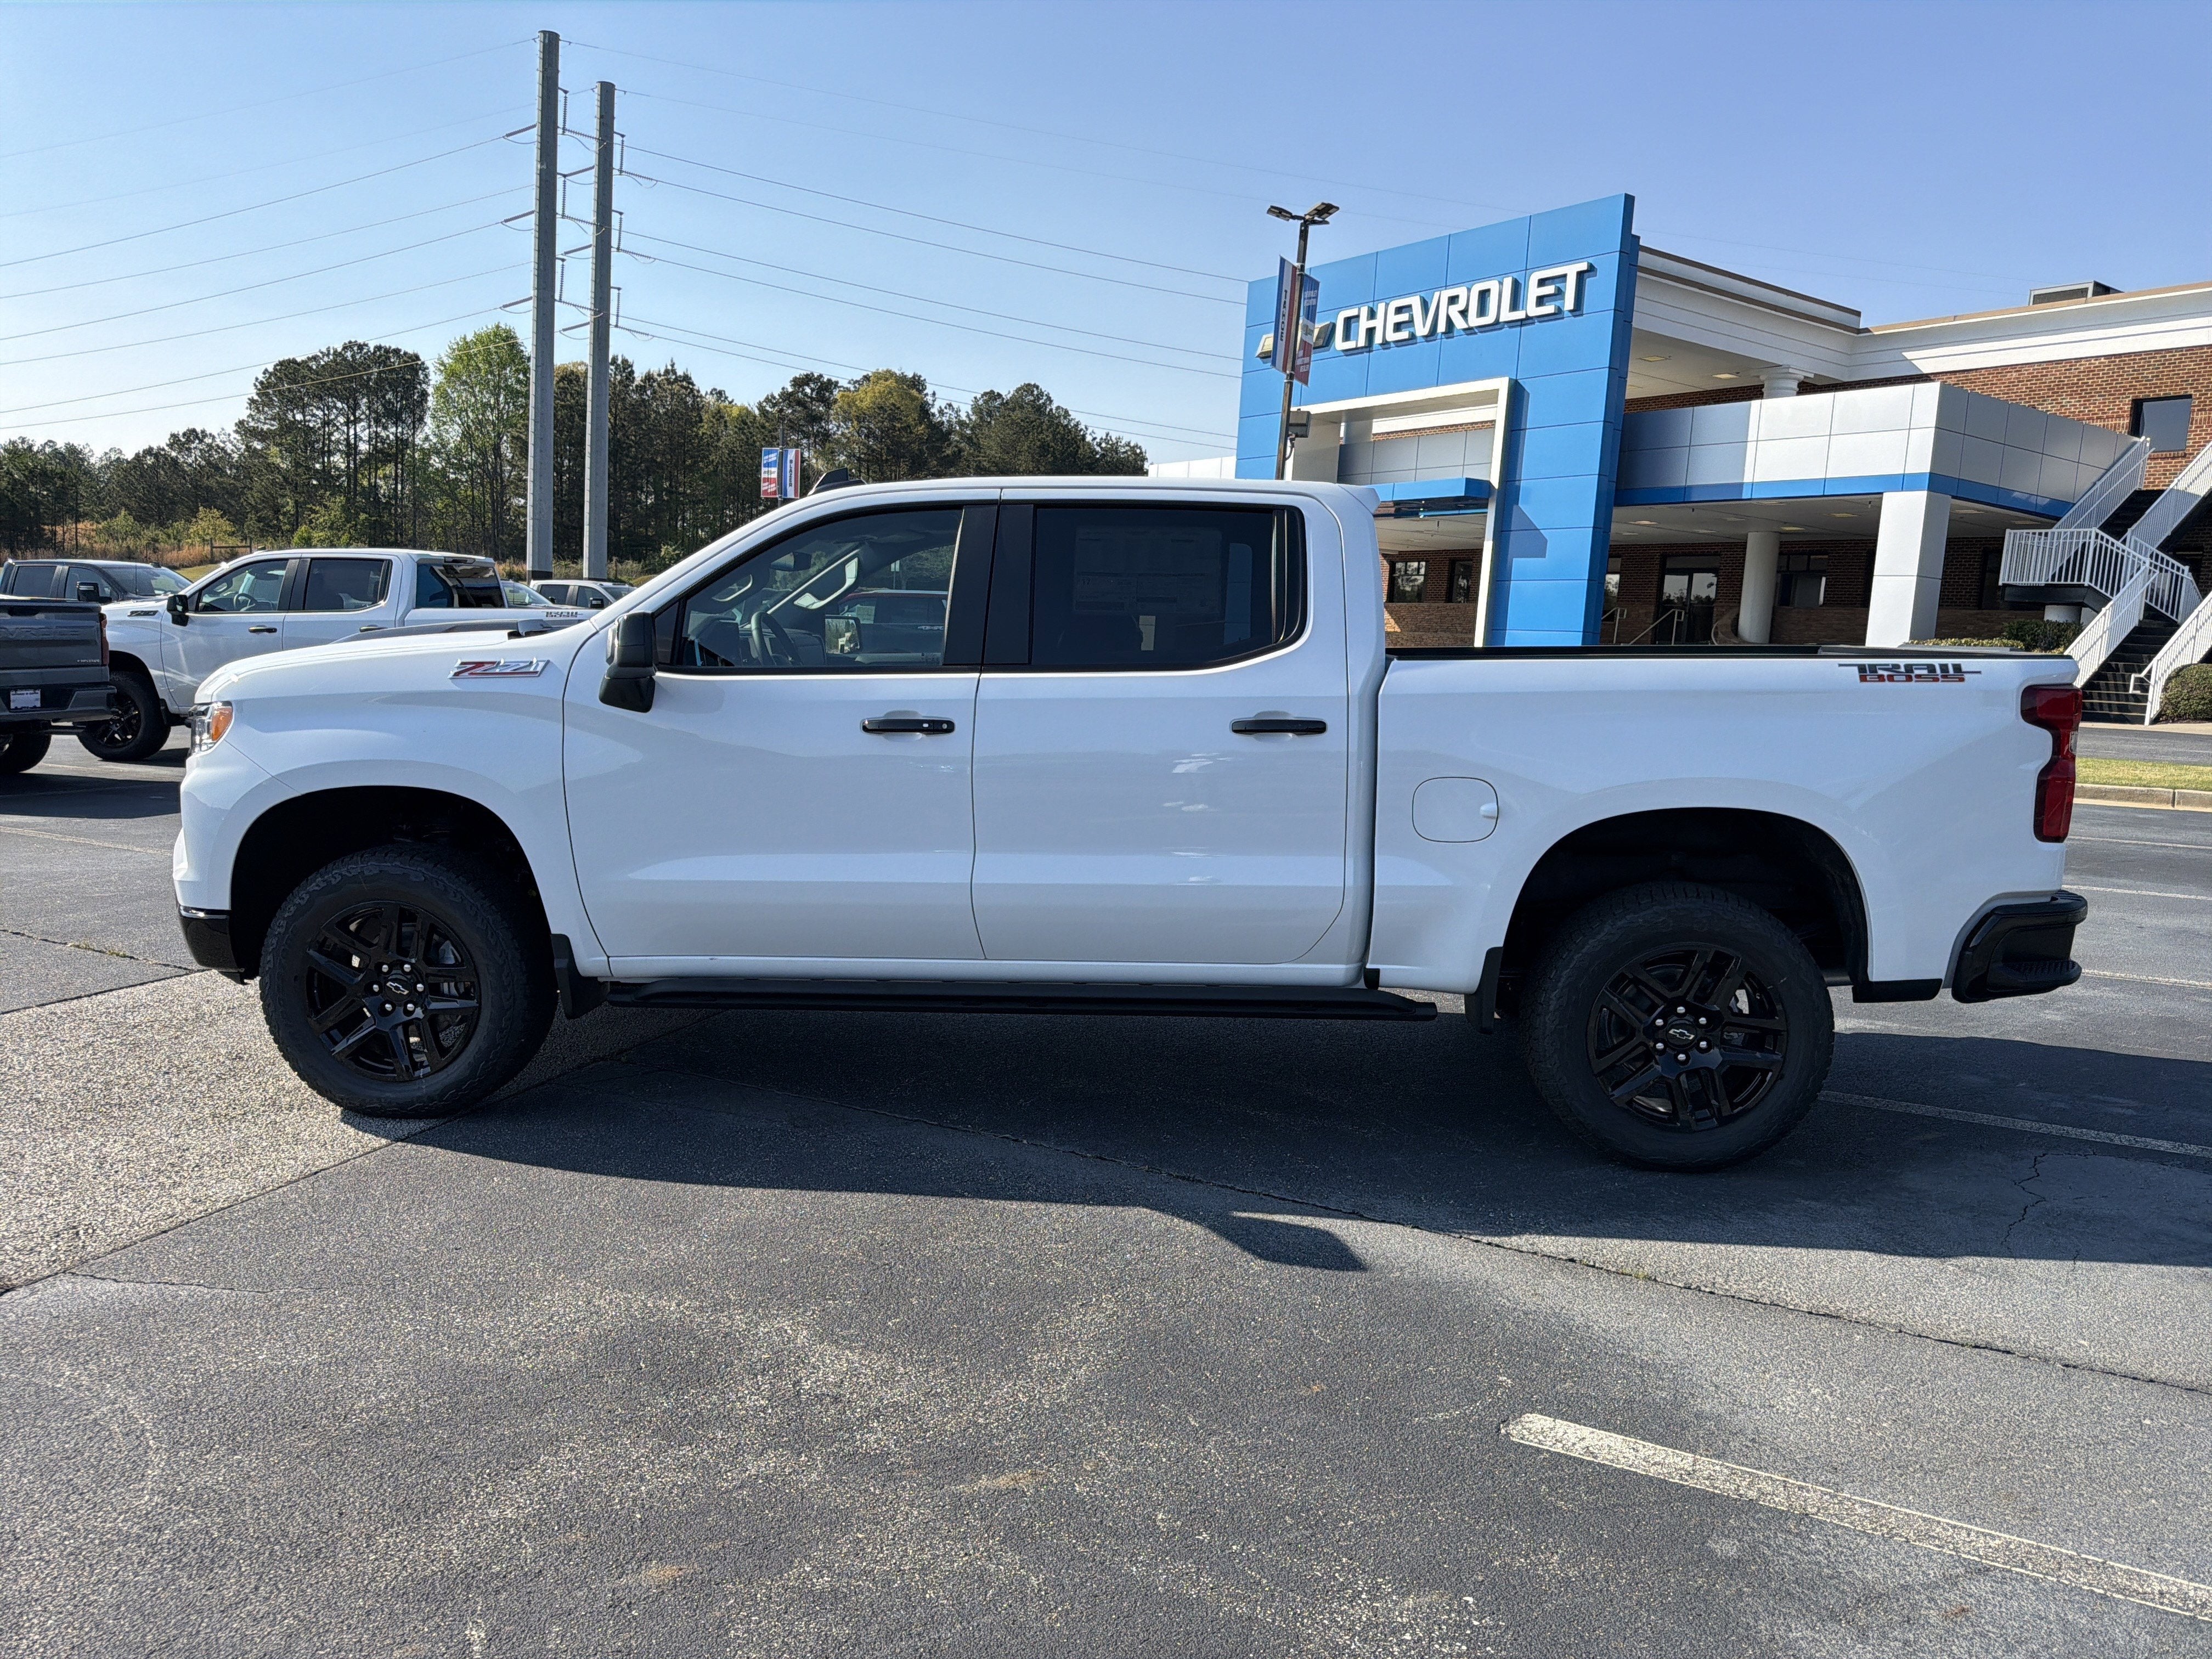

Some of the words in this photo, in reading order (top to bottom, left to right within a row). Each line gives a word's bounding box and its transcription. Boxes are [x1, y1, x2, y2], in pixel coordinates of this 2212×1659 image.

[1280, 289, 1288, 342] TAHOE
[1335, 261, 1592, 352] CHEVROLET
[448, 658, 550, 679] Z71
[1838, 663, 1982, 674] TRAIL
[1859, 674, 1966, 683] BOSS
